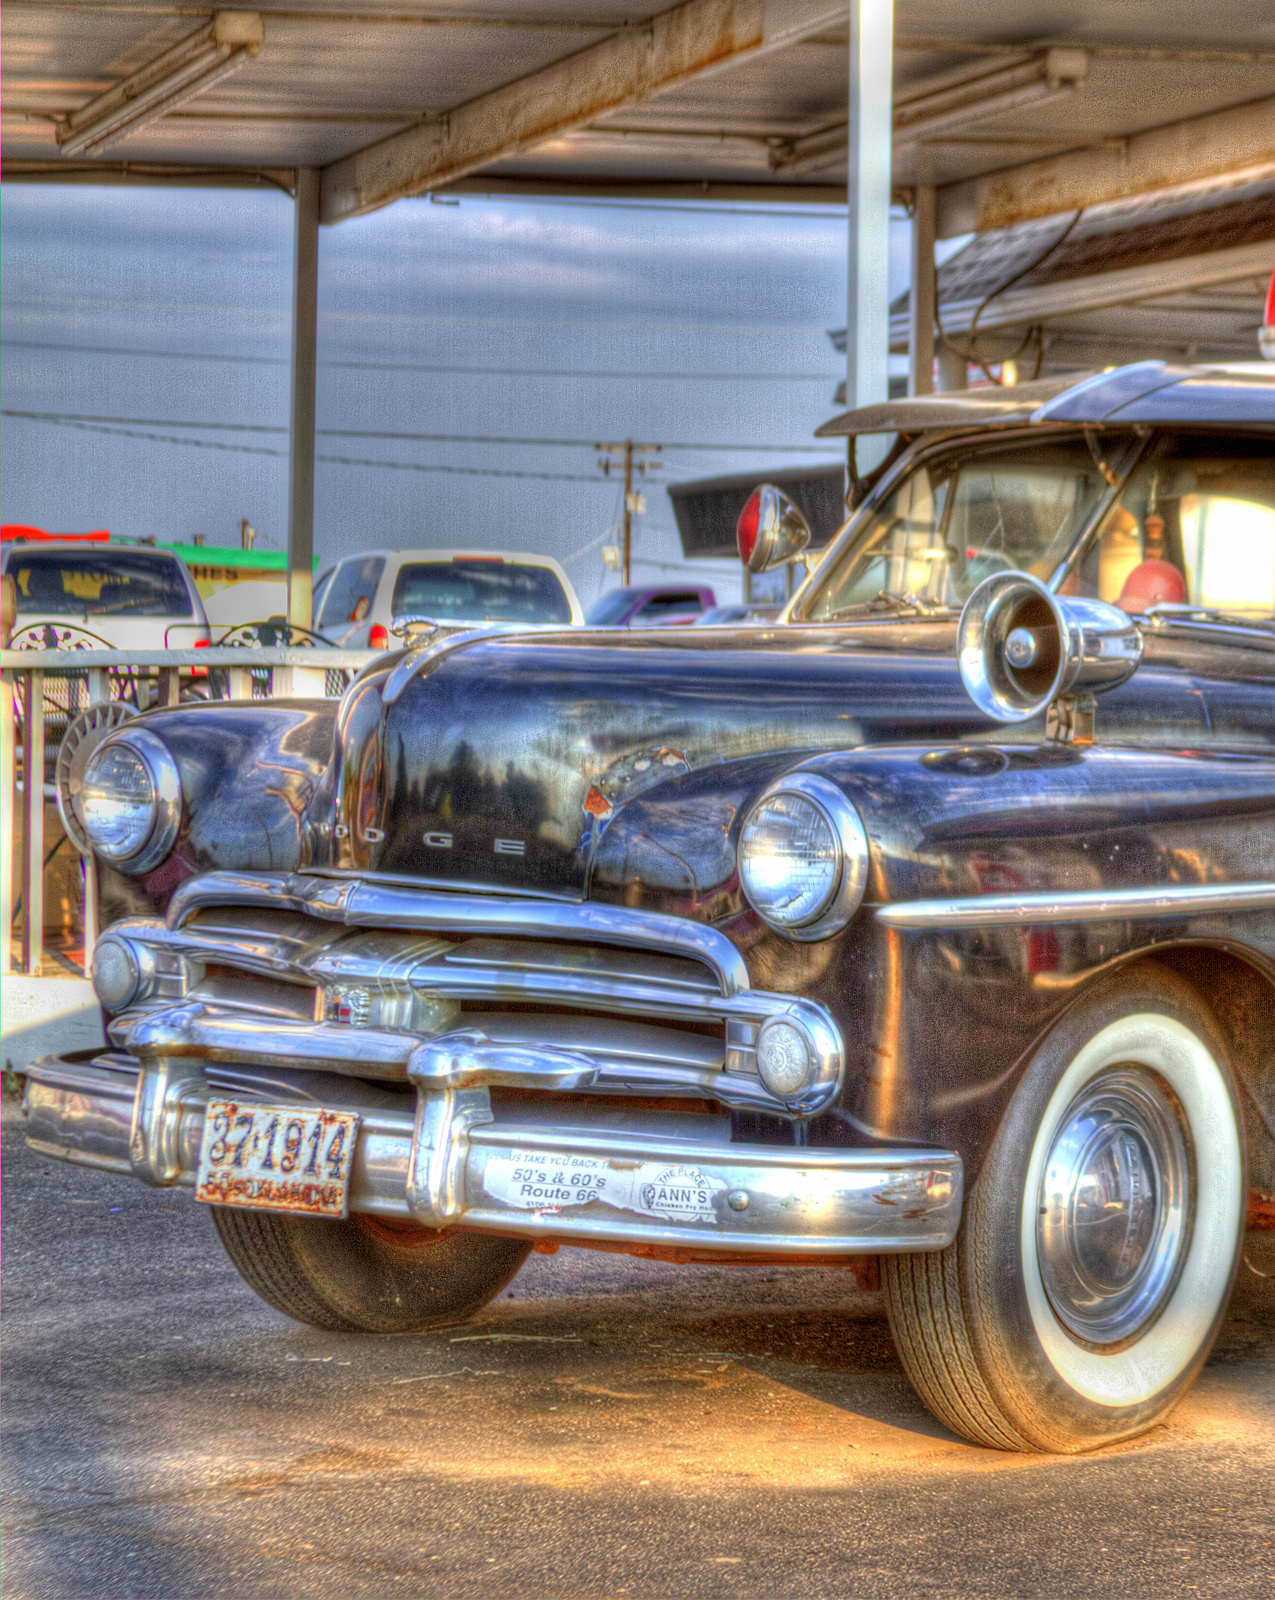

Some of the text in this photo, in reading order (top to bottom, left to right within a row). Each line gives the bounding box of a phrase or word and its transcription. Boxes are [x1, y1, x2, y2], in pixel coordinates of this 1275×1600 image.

[319, 822, 526, 856] DODGE
[524, 1154, 548, 1165] TAKE
[550, 1156, 569, 1166] YOU
[571, 1158, 598, 1169] BACK
[512, 1168, 607, 1188] 50's & 60's
[658, 1167, 706, 1187] THE PLACE
[520, 1184, 598, 1201] Route 66
[658, 1187, 707, 1204] ANN'S
[655, 1201, 684, 1209] Chicken
